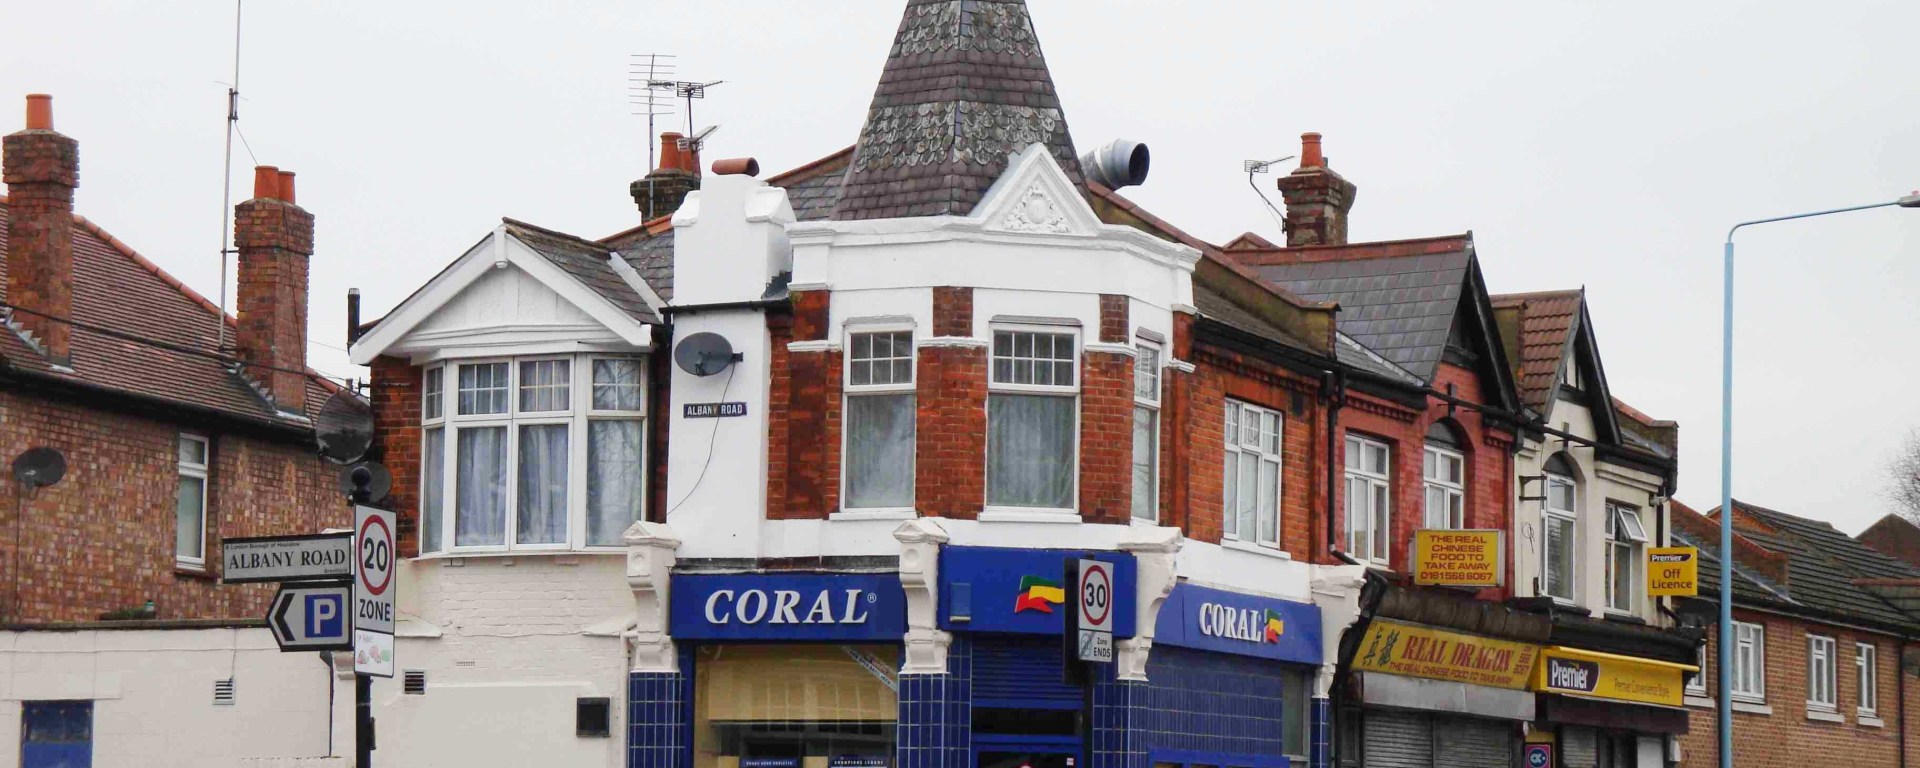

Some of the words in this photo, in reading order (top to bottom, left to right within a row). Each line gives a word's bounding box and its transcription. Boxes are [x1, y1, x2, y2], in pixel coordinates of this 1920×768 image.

[687, 404, 718, 416] ALBANY
[721, 404, 743, 415] ROAD
[1429, 534, 1453, 543] THE
[1455, 535, 1487, 544] REAL
[363, 537, 388, 572] 20
[1431, 544, 1484, 553] CHINESE
[229, 551, 294, 570] ALBANY
[301, 549, 346, 567] ROAD
[1431, 553, 1465, 561] FOOD
[1467, 553, 1484, 561] TO
[1651, 554, 1683, 562] Premier
[1424, 562, 1456, 570] TAKE
[1458, 562, 1491, 571] AWAY
[1663, 568, 1682, 579] Off
[1651, 579, 1693, 589] Licence
[1085, 582, 1107, 608] 30
[359, 598, 391, 622] ZONE
[313, 598, 337, 635] P
[1199, 602, 1262, 643] CORAL
[1093, 646, 1111, 658] ENDS
[1401, 634, 1448, 665] REAL
[1452, 641, 1515, 673] DRAGON
[1389, 661, 1404, 671] THE
[1551, 659, 1589, 689] Premier
